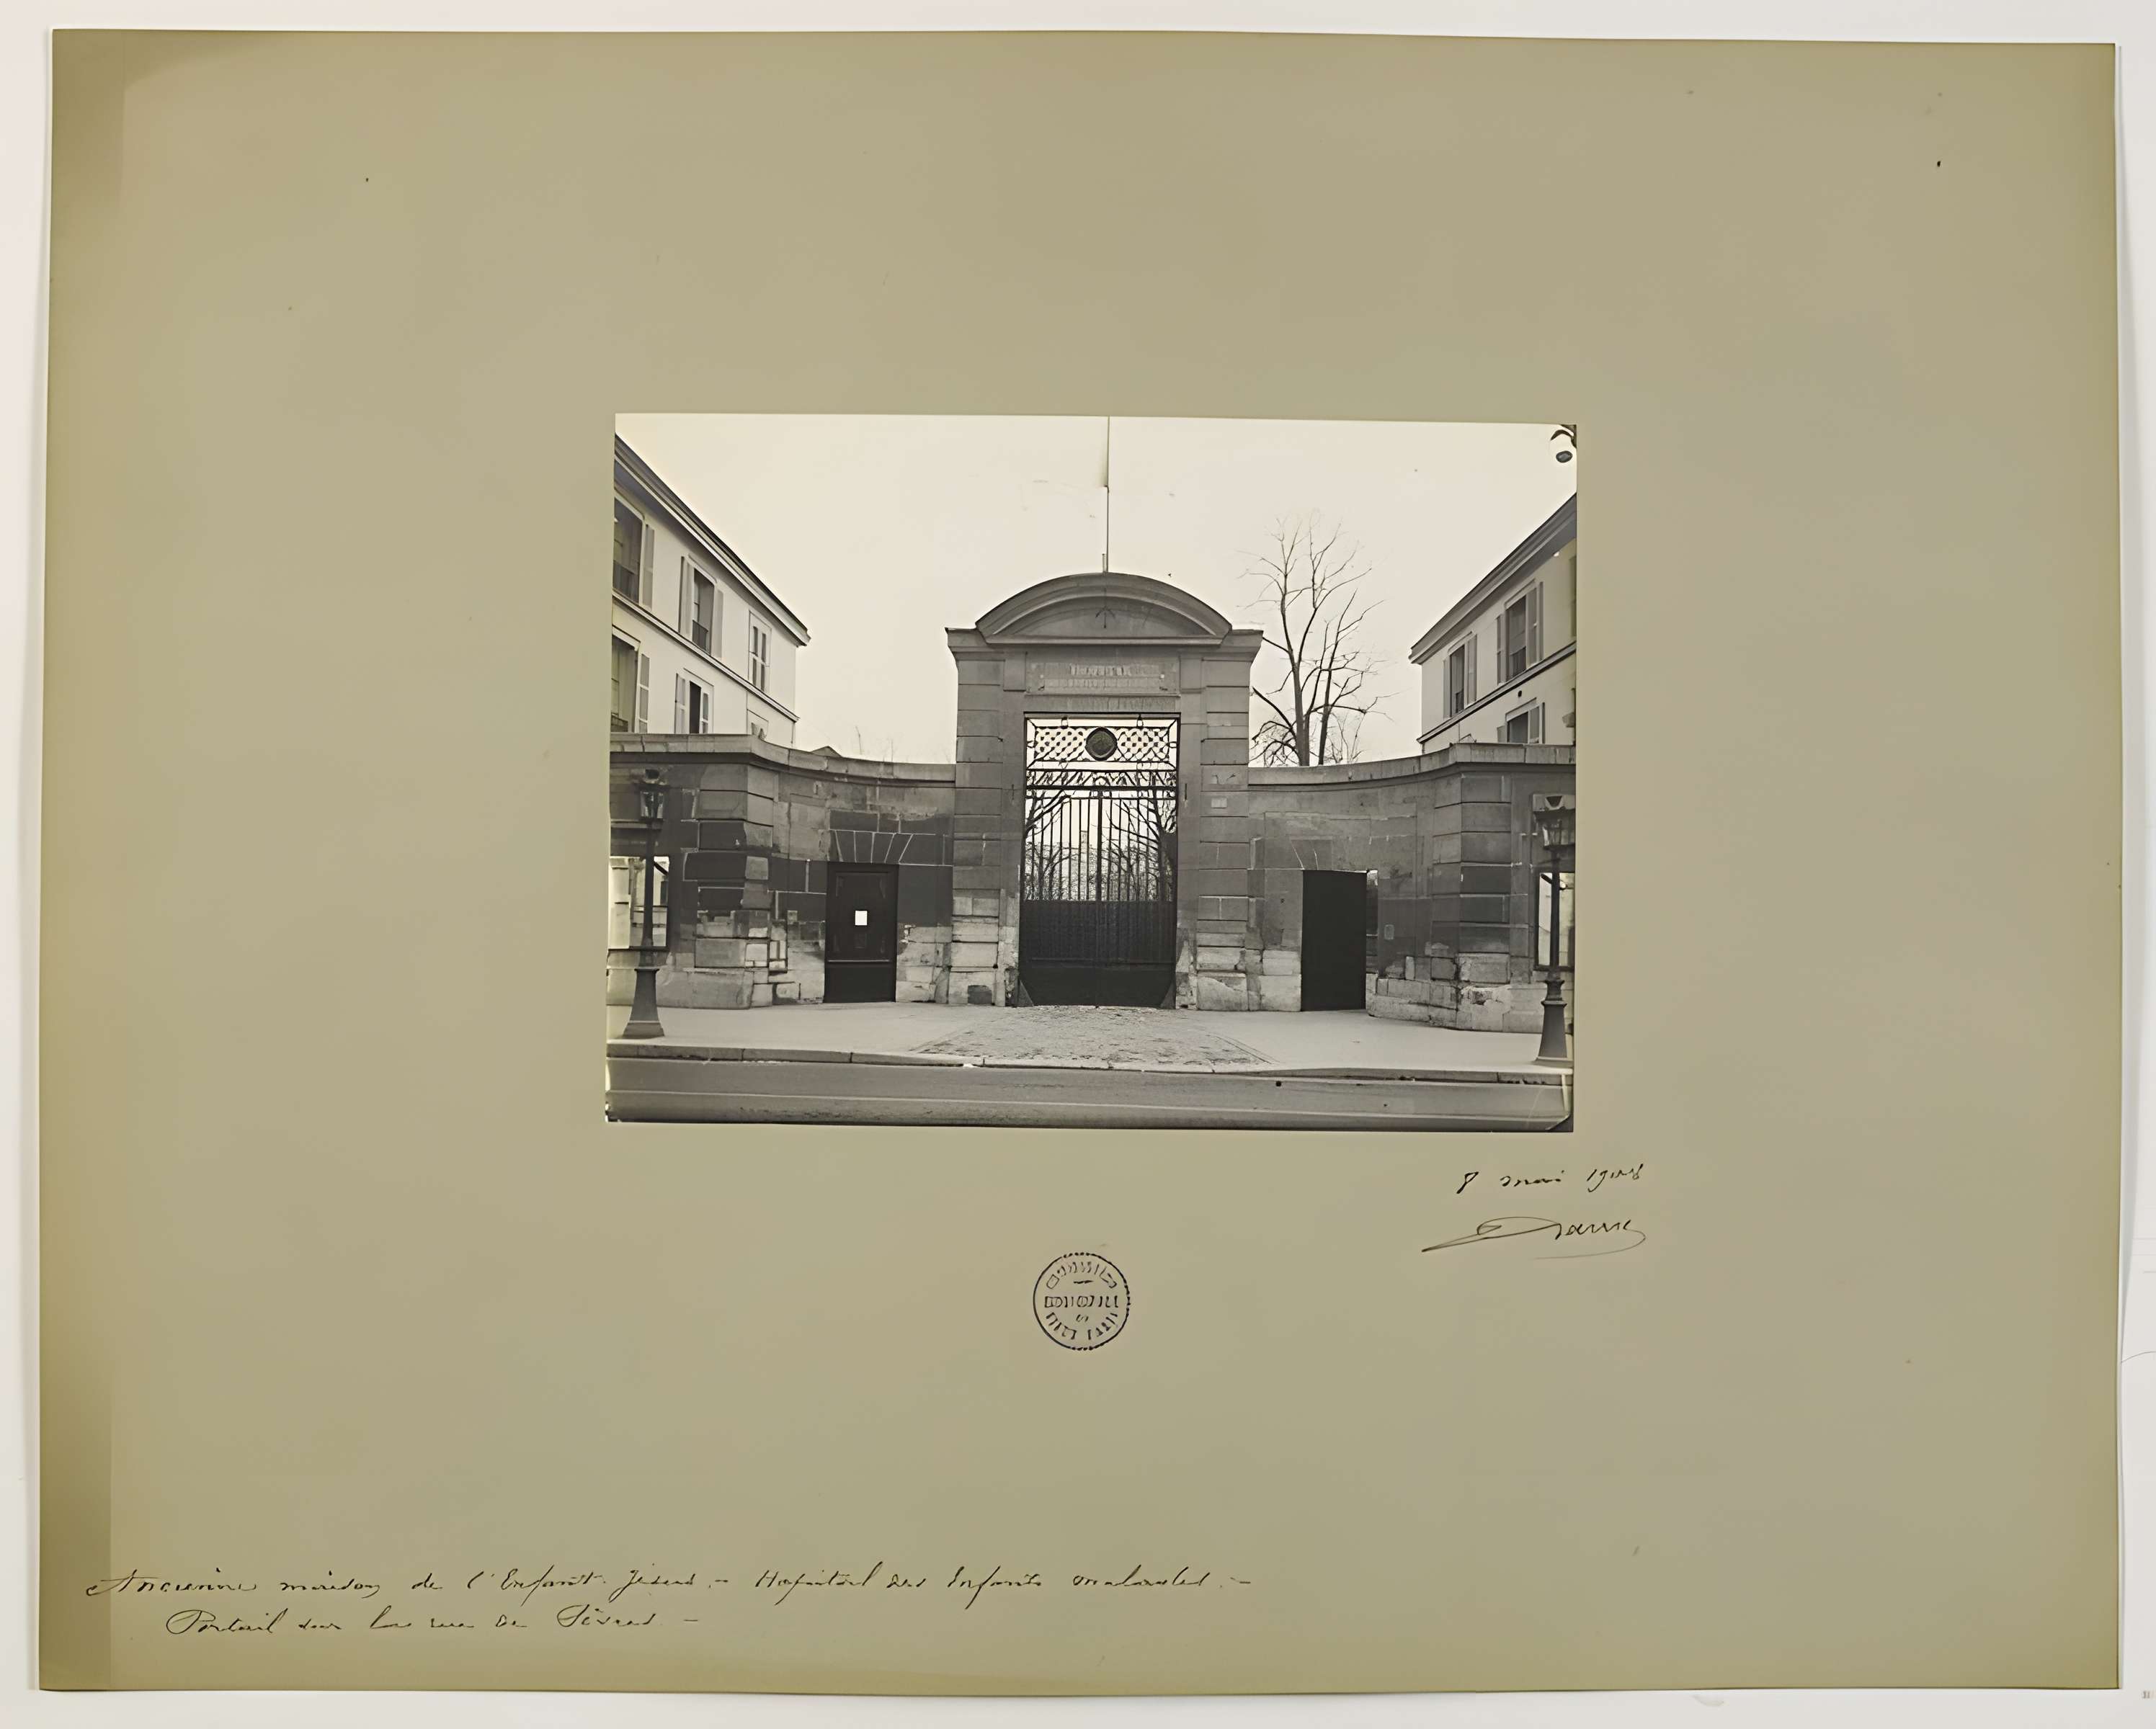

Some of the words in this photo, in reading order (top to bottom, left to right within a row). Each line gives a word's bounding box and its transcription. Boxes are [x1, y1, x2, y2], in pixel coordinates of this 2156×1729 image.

[1499, 1169, 1565, 1187] mai
[85, 1568, 257, 1597] Ancienne
[279, 1570, 380, 1599] maison
[411, 1572, 443, 1591] de
[886, 1573, 927, 1589] des
[165, 1607, 289, 1635] Portail
[298, 1618, 342, 1631] sur
[369, 1604, 412, 1630] la
[430, 1617, 475, 1629] rue
[495, 1614, 527, 1628] de
